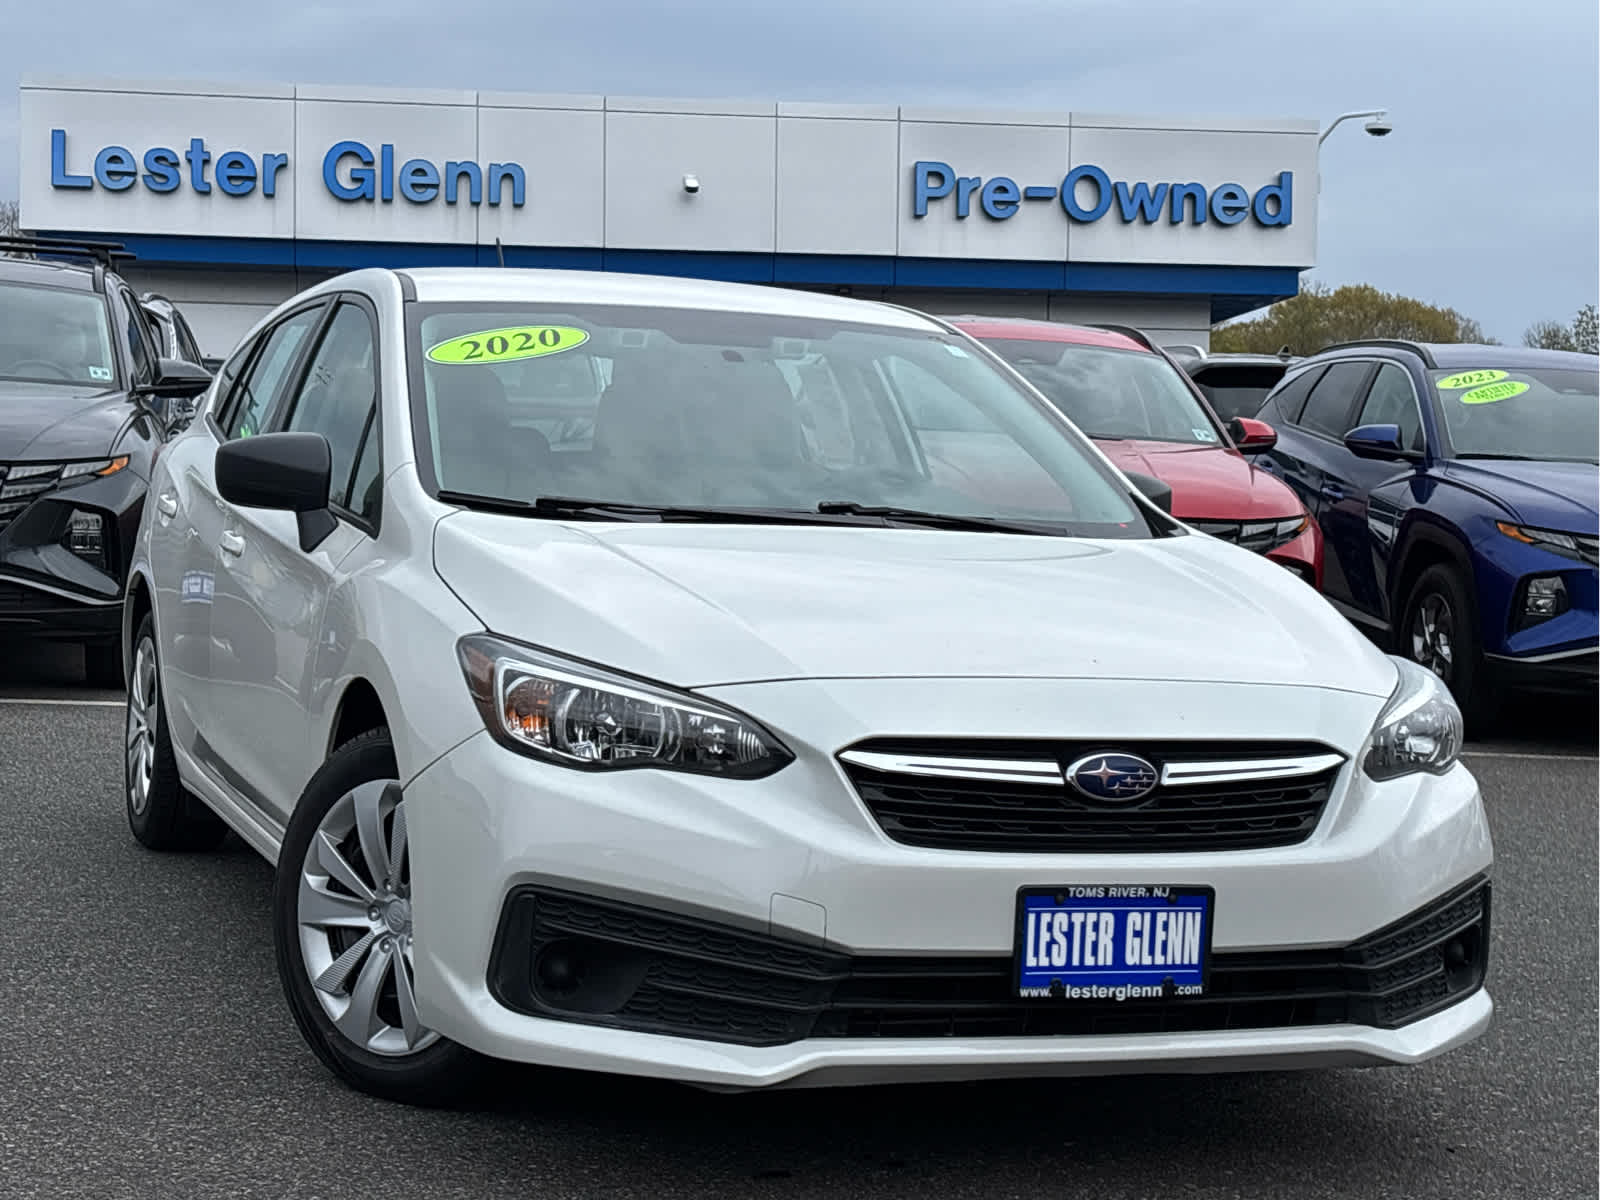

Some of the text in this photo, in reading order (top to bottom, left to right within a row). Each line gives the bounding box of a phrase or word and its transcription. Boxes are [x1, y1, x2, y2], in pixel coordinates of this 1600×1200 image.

[50, 128, 526, 207] Lester Glenn
[912, 160, 1294, 228] Pre-Owned
[459, 328, 561, 361] 2020
[1450, 370, 1497, 388] 2023
[1068, 887, 1106, 898] TOMS
[1152, 887, 1170, 898] NJ
[1025, 911, 1202, 968] LESTER GLENN
[1064, 984, 1163, 1001] lesterglenn
